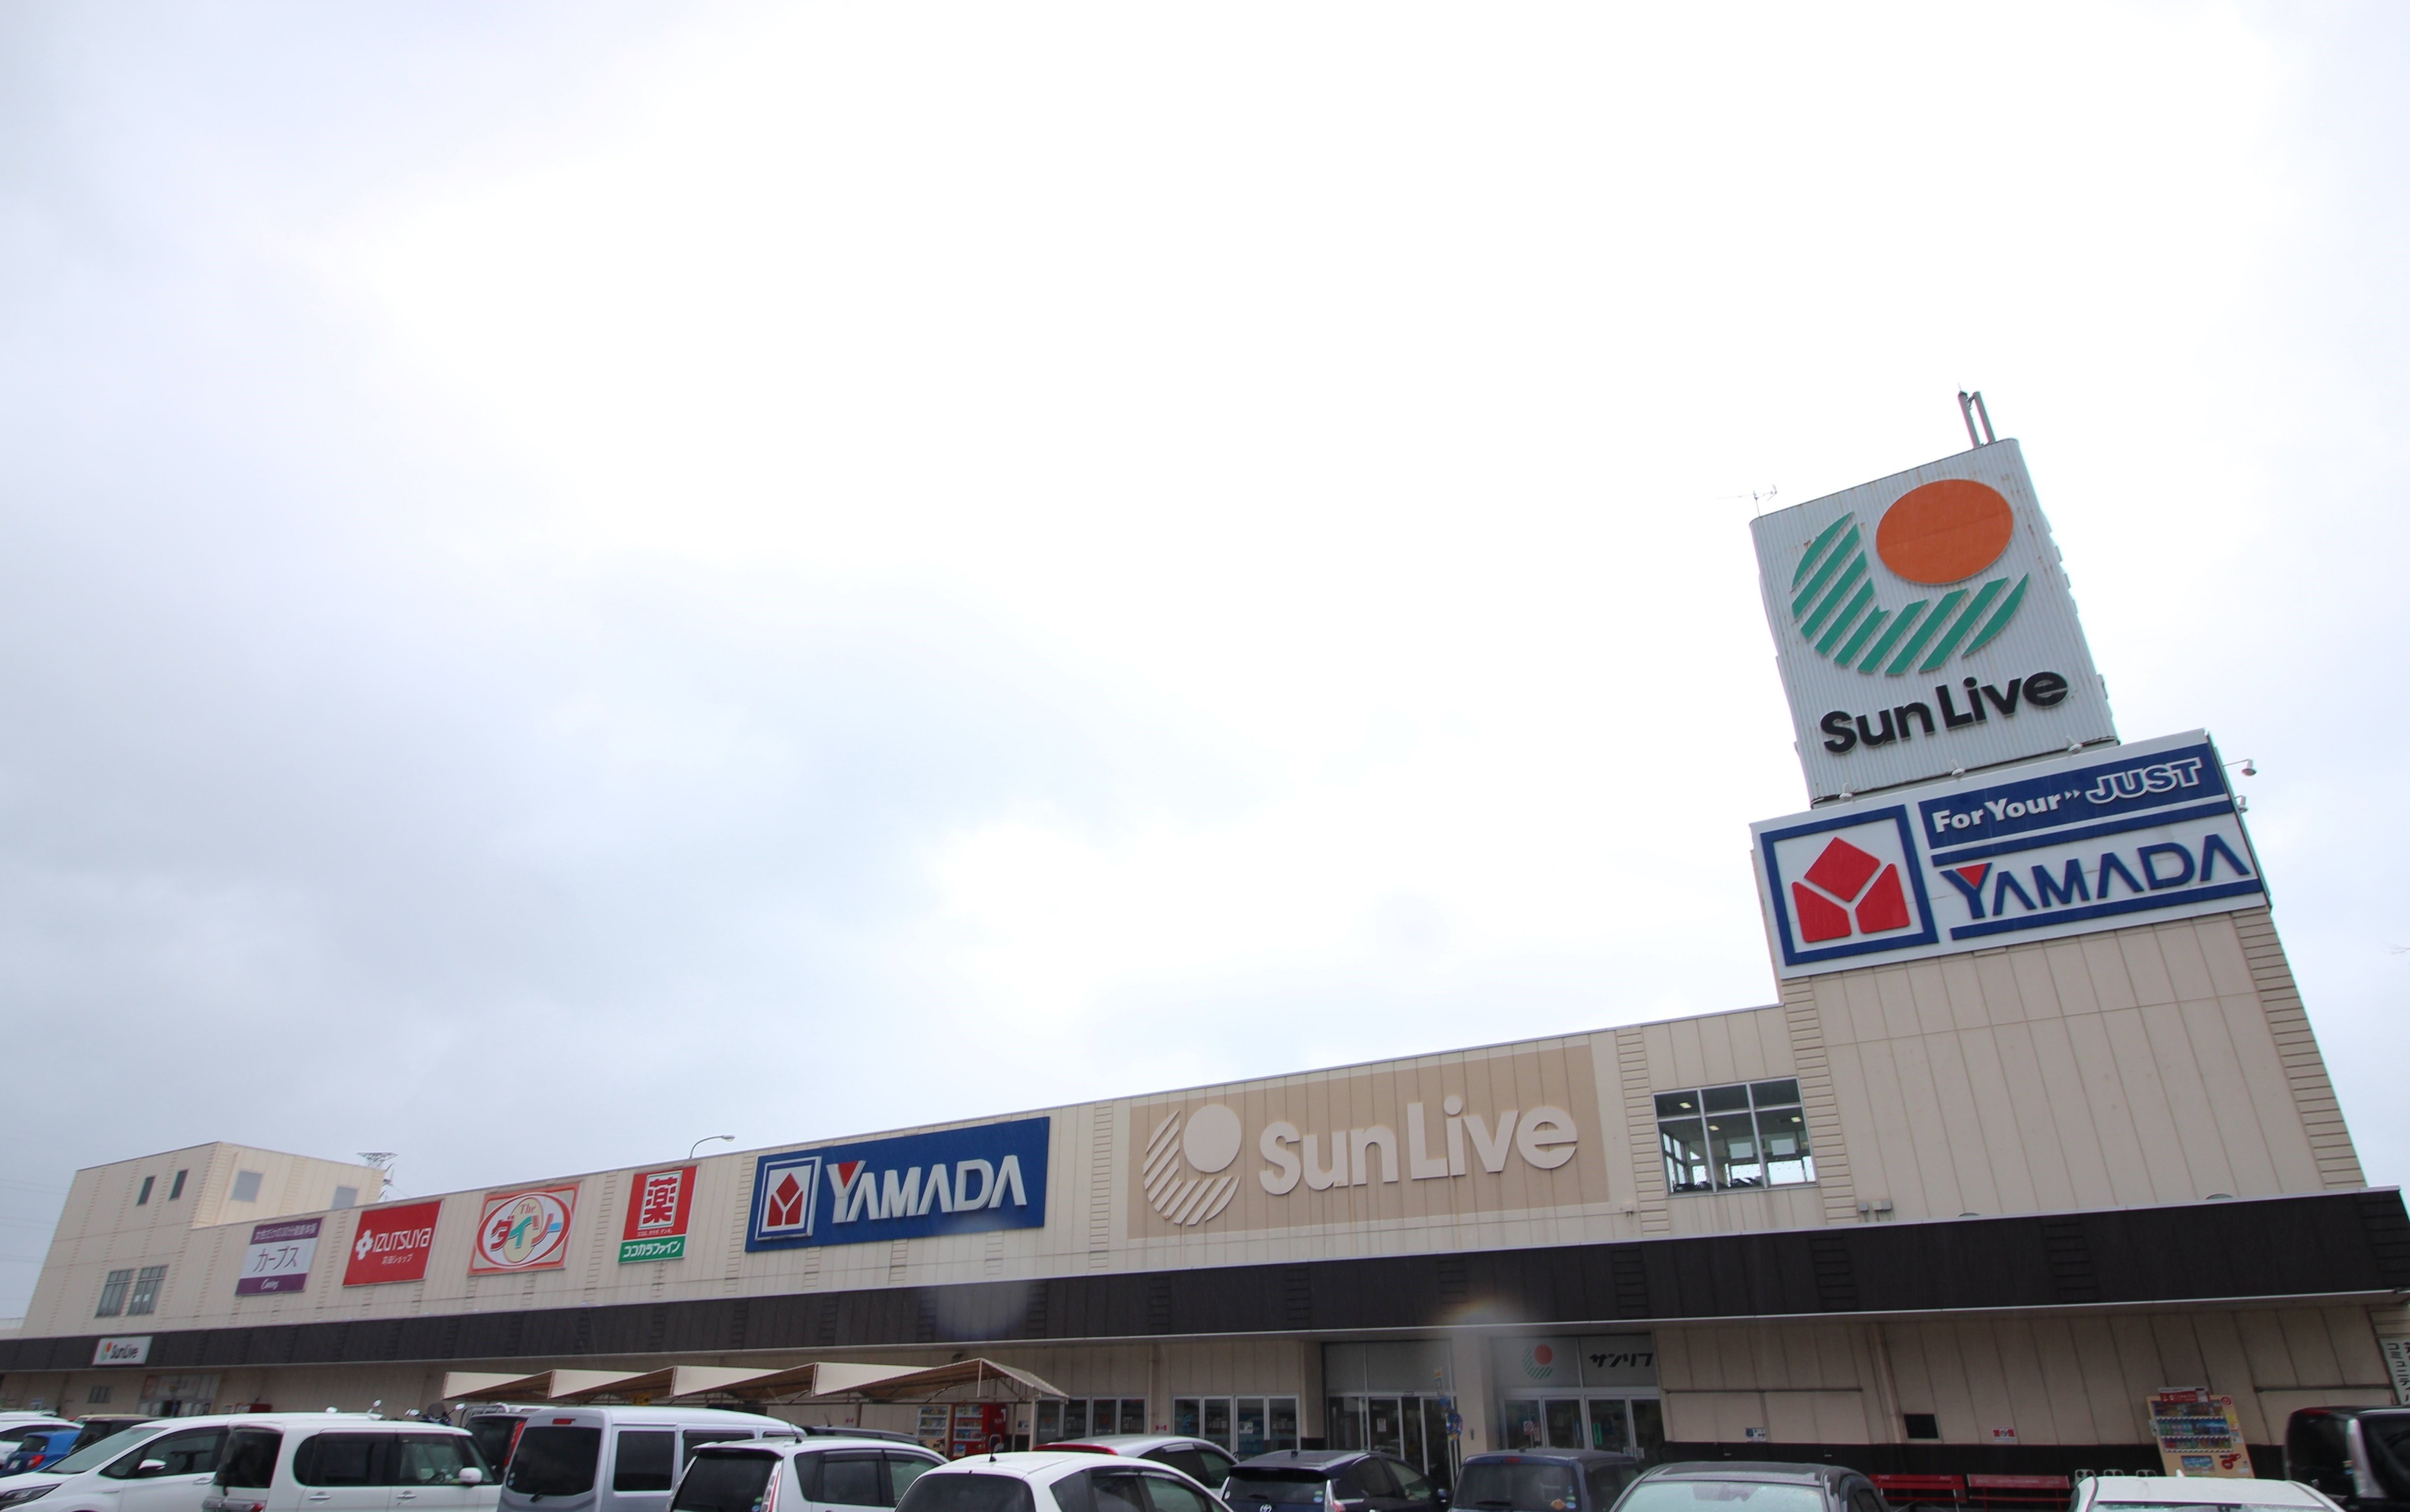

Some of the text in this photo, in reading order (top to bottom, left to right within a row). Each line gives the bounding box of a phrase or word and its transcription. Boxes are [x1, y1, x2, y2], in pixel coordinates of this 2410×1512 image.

[2086, 756, 2203, 804] JUST
[1940, 834, 2250, 919] YAMADA
[520, 1203, 536, 1215] The
[643, 1176, 678, 1224] 薬
[826, 1154, 1027, 1224] YAMADA
[490, 1212, 562, 1252] ダイソー
[623, 1241, 681, 1258] ココカラファイン
